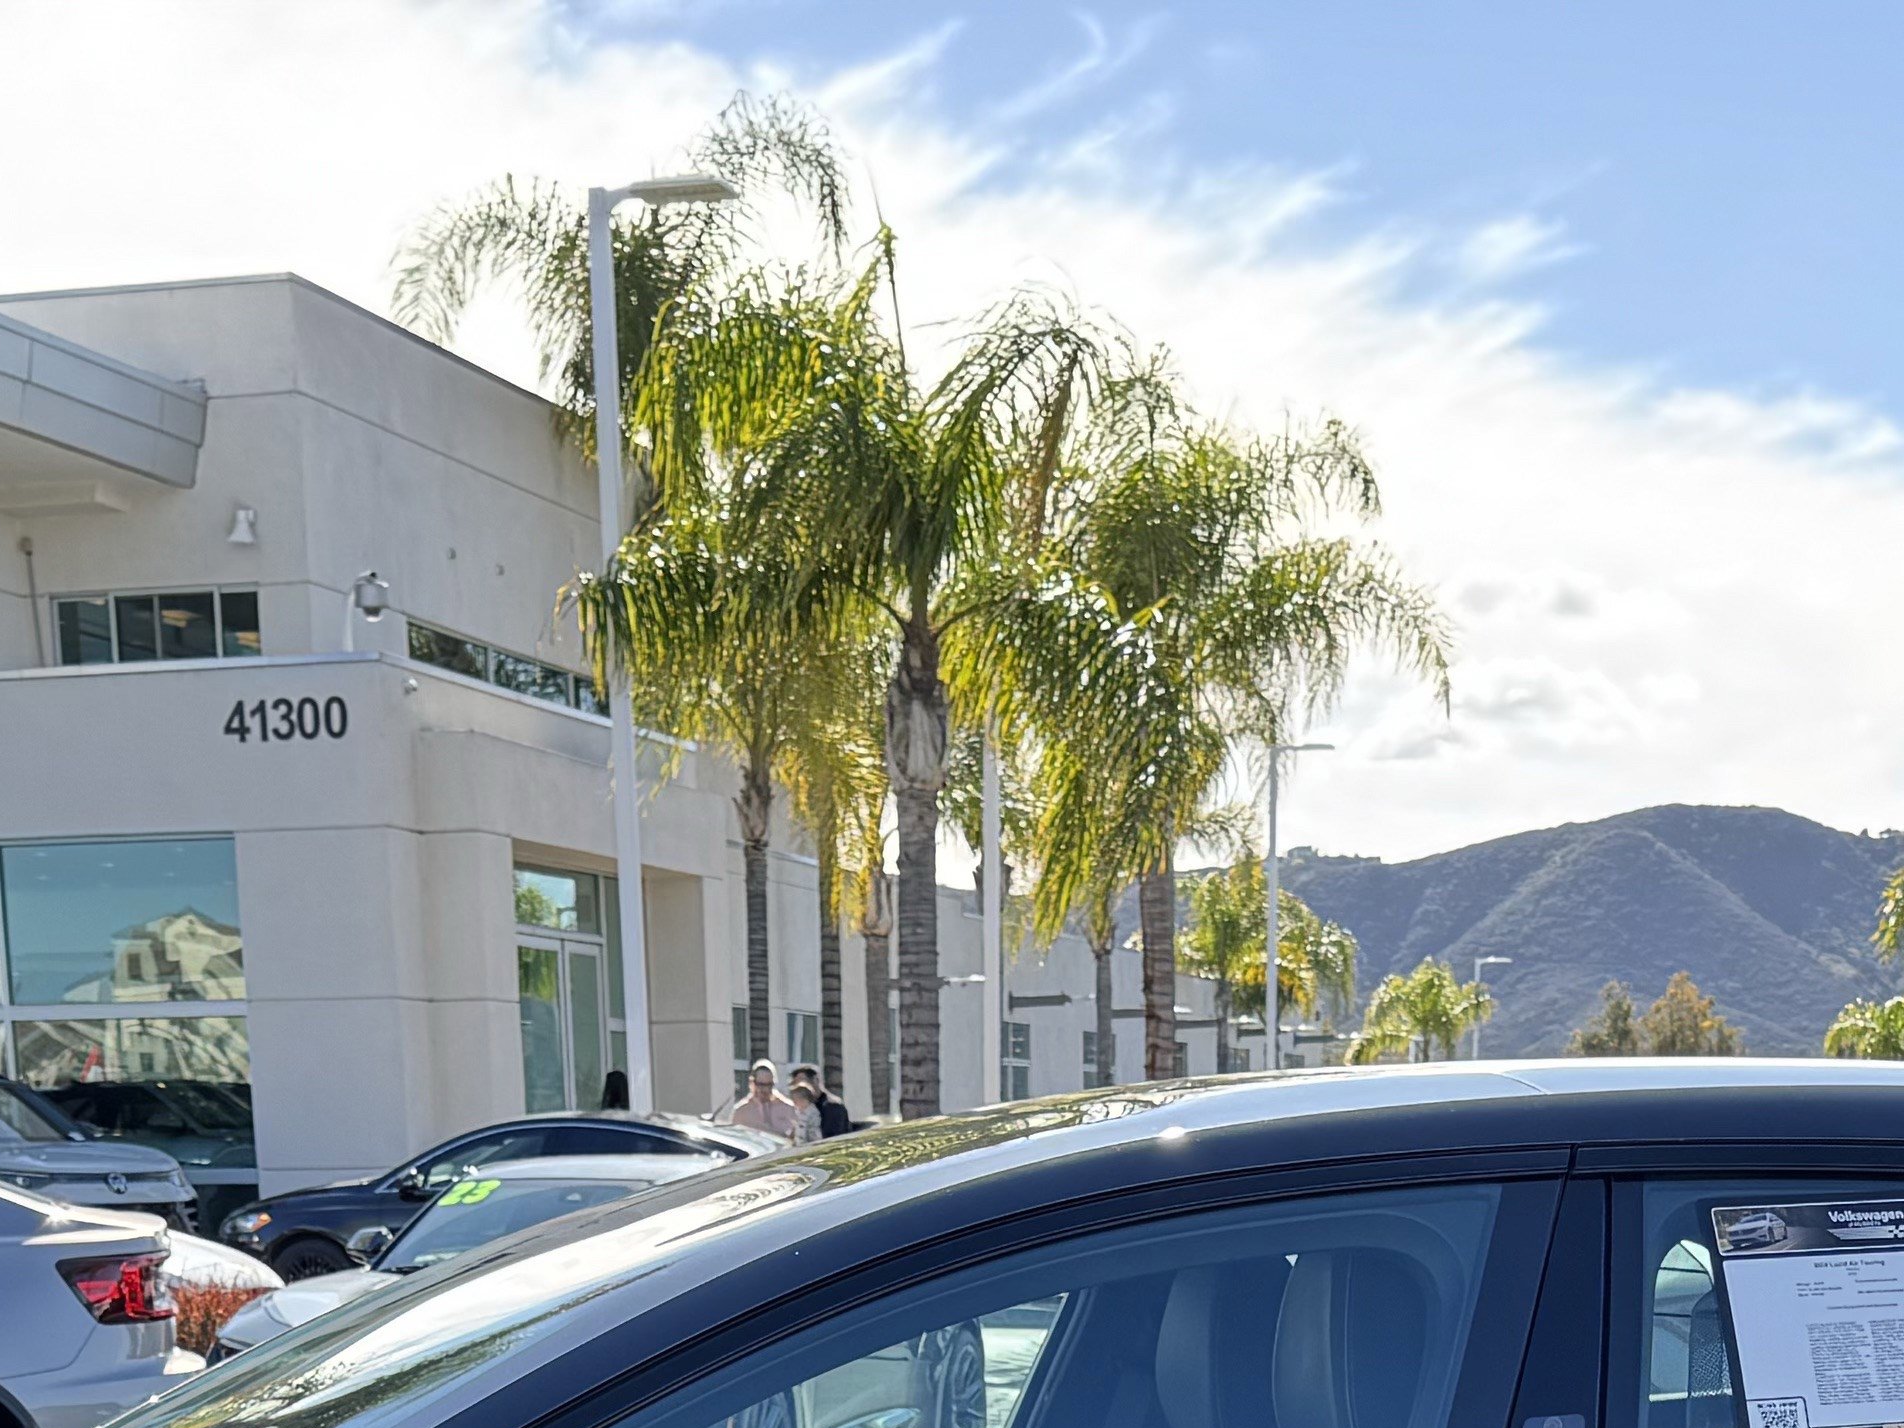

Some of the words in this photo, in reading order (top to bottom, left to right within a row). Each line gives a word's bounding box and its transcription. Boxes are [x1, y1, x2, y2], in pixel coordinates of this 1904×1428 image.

[223, 696, 348, 743] 41300
[437, 1179, 501, 1207] 23
[1828, 1209, 1904, 1224] Volkswagen
